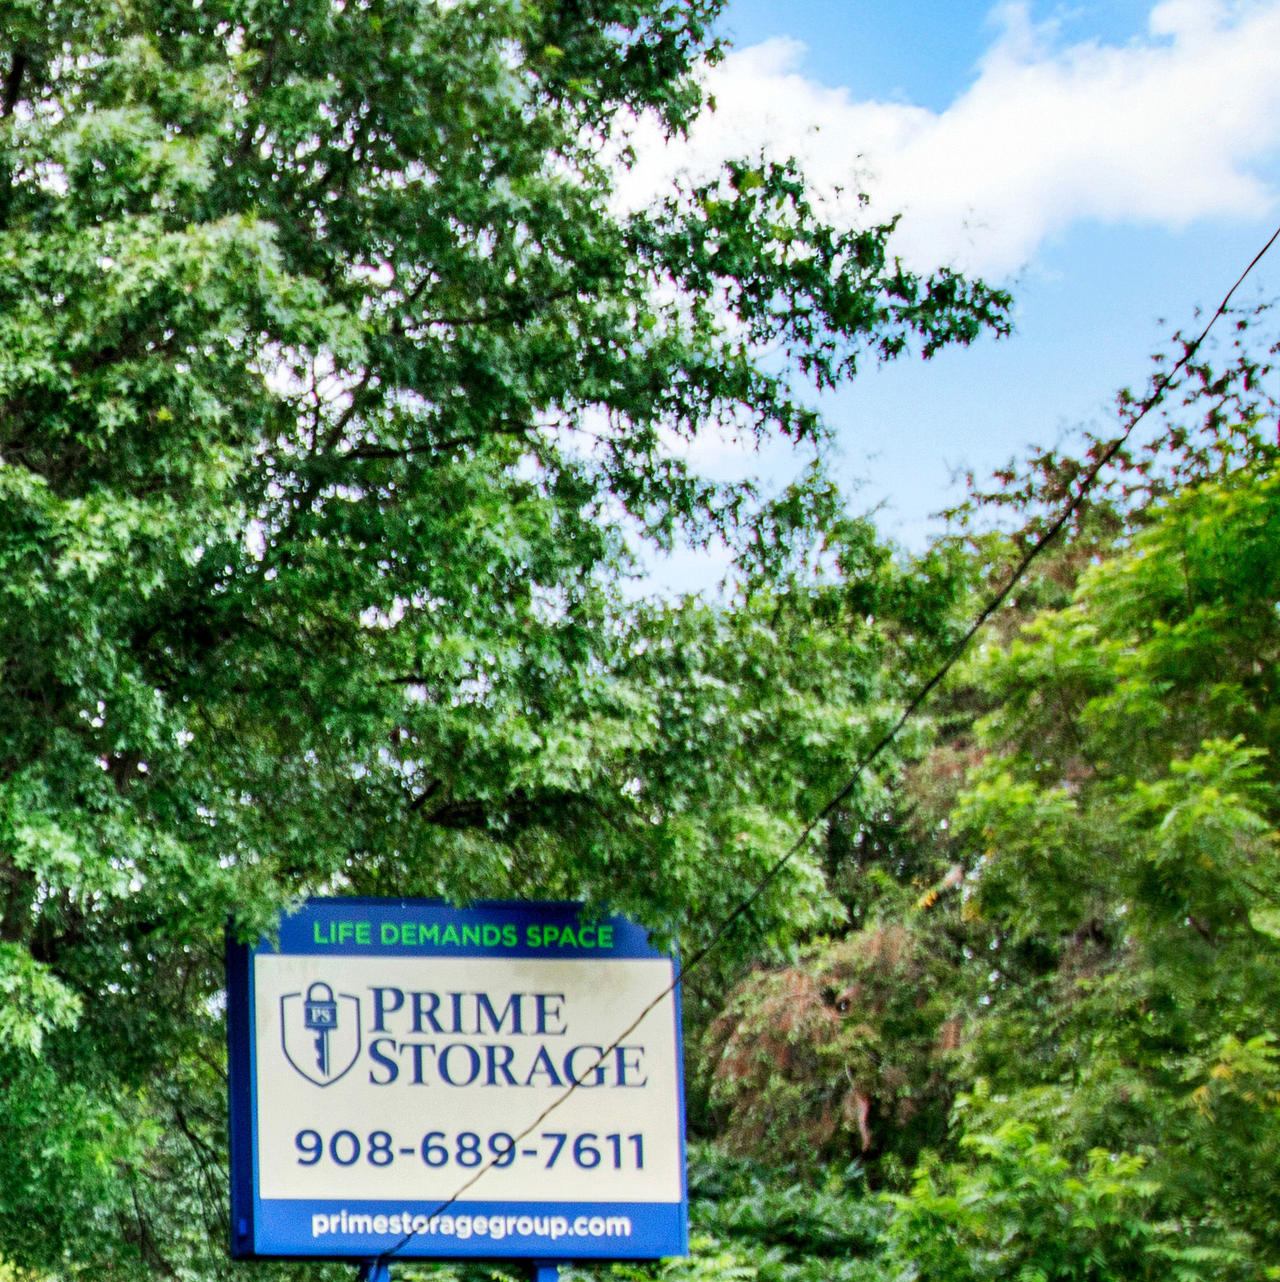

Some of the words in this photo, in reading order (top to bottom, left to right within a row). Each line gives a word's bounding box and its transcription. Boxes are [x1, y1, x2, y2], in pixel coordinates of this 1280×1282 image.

[313, 921, 371, 945] LIFE
[381, 922, 517, 947] DEMANDS
[526, 924, 614, 949] SPACE
[311, 1008, 331, 1024] PS
[367, 986, 567, 1035] PRIME
[368, 1039, 647, 1088] STORAGE
[295, 1129, 645, 1169] 908-689-7611
[312, 1210, 632, 1239] primestoragegroup.com
